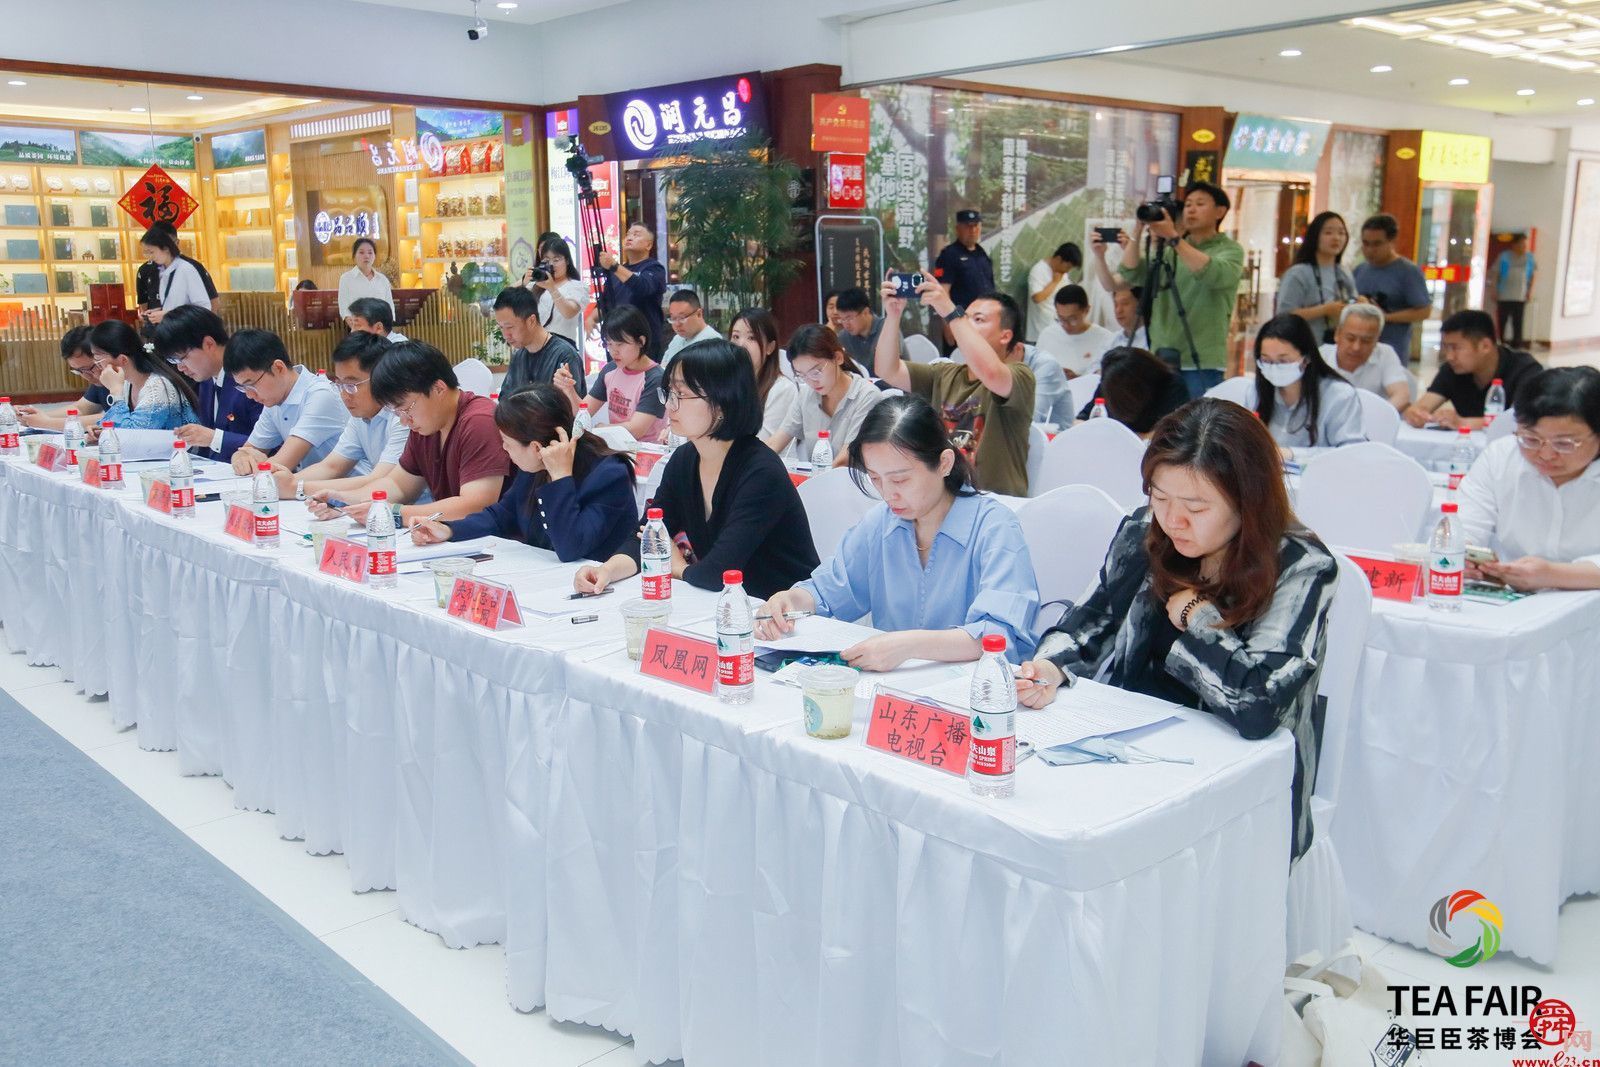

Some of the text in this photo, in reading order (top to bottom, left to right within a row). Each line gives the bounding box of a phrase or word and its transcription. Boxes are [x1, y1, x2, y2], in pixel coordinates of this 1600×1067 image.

[658, 91, 741, 133] 润元昌
[880, 151, 896, 202] 基地
[139, 181, 180, 223] 福
[898, 152, 915, 249] 百年荒野
[649, 643, 709, 680] 凤凰网
[879, 702, 969, 746] 山东广播
[887, 729, 947, 766] 电视台
